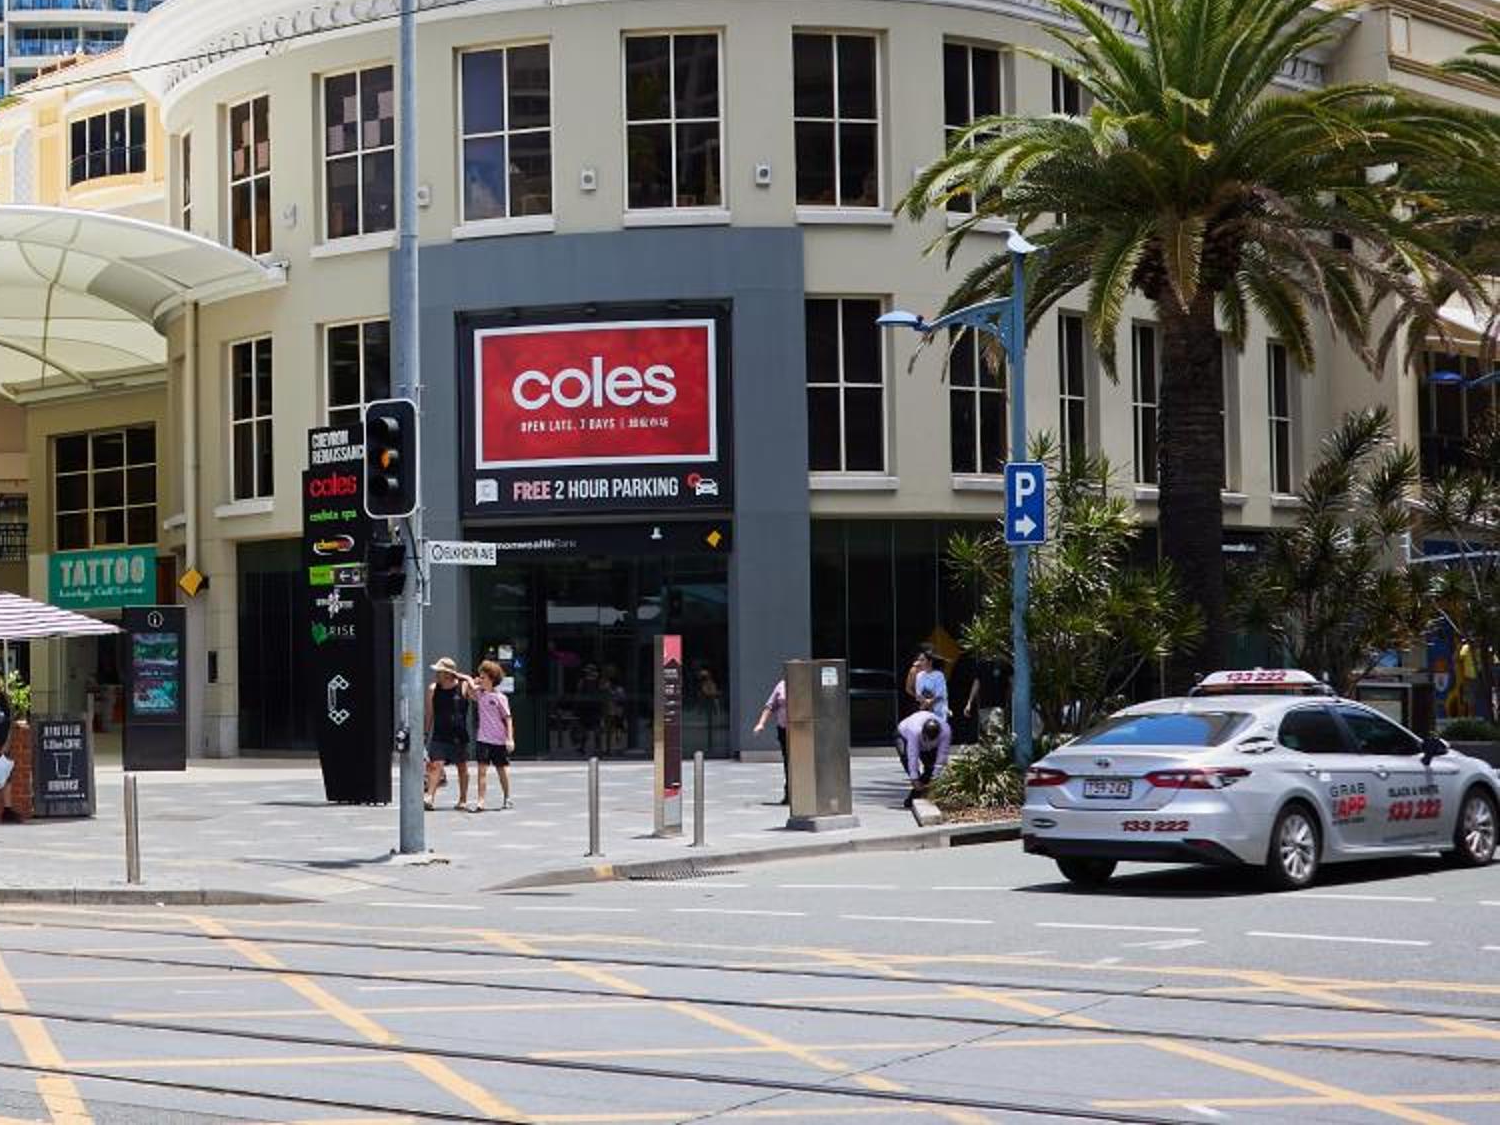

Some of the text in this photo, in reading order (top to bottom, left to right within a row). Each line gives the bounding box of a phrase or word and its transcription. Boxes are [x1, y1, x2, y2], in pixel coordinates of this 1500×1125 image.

[512, 356, 677, 410] coles
[520, 420, 545, 432] OPEN
[589, 418, 615, 429] DAYS
[312, 430, 349, 448] CHEVRON
[310, 472, 357, 497] coles
[513, 477, 679, 501] FREE 2 HOUR PARKING
[1015, 472, 1036, 508] P
[60, 556, 145, 587] TATTOO
[1255, 671, 1287, 682] 222
[1331, 782, 1365, 797] GRAB
[1387, 800, 1414, 822] 133
[1414, 797, 1443, 820] 222
[1122, 820, 1188, 832] 133 222
